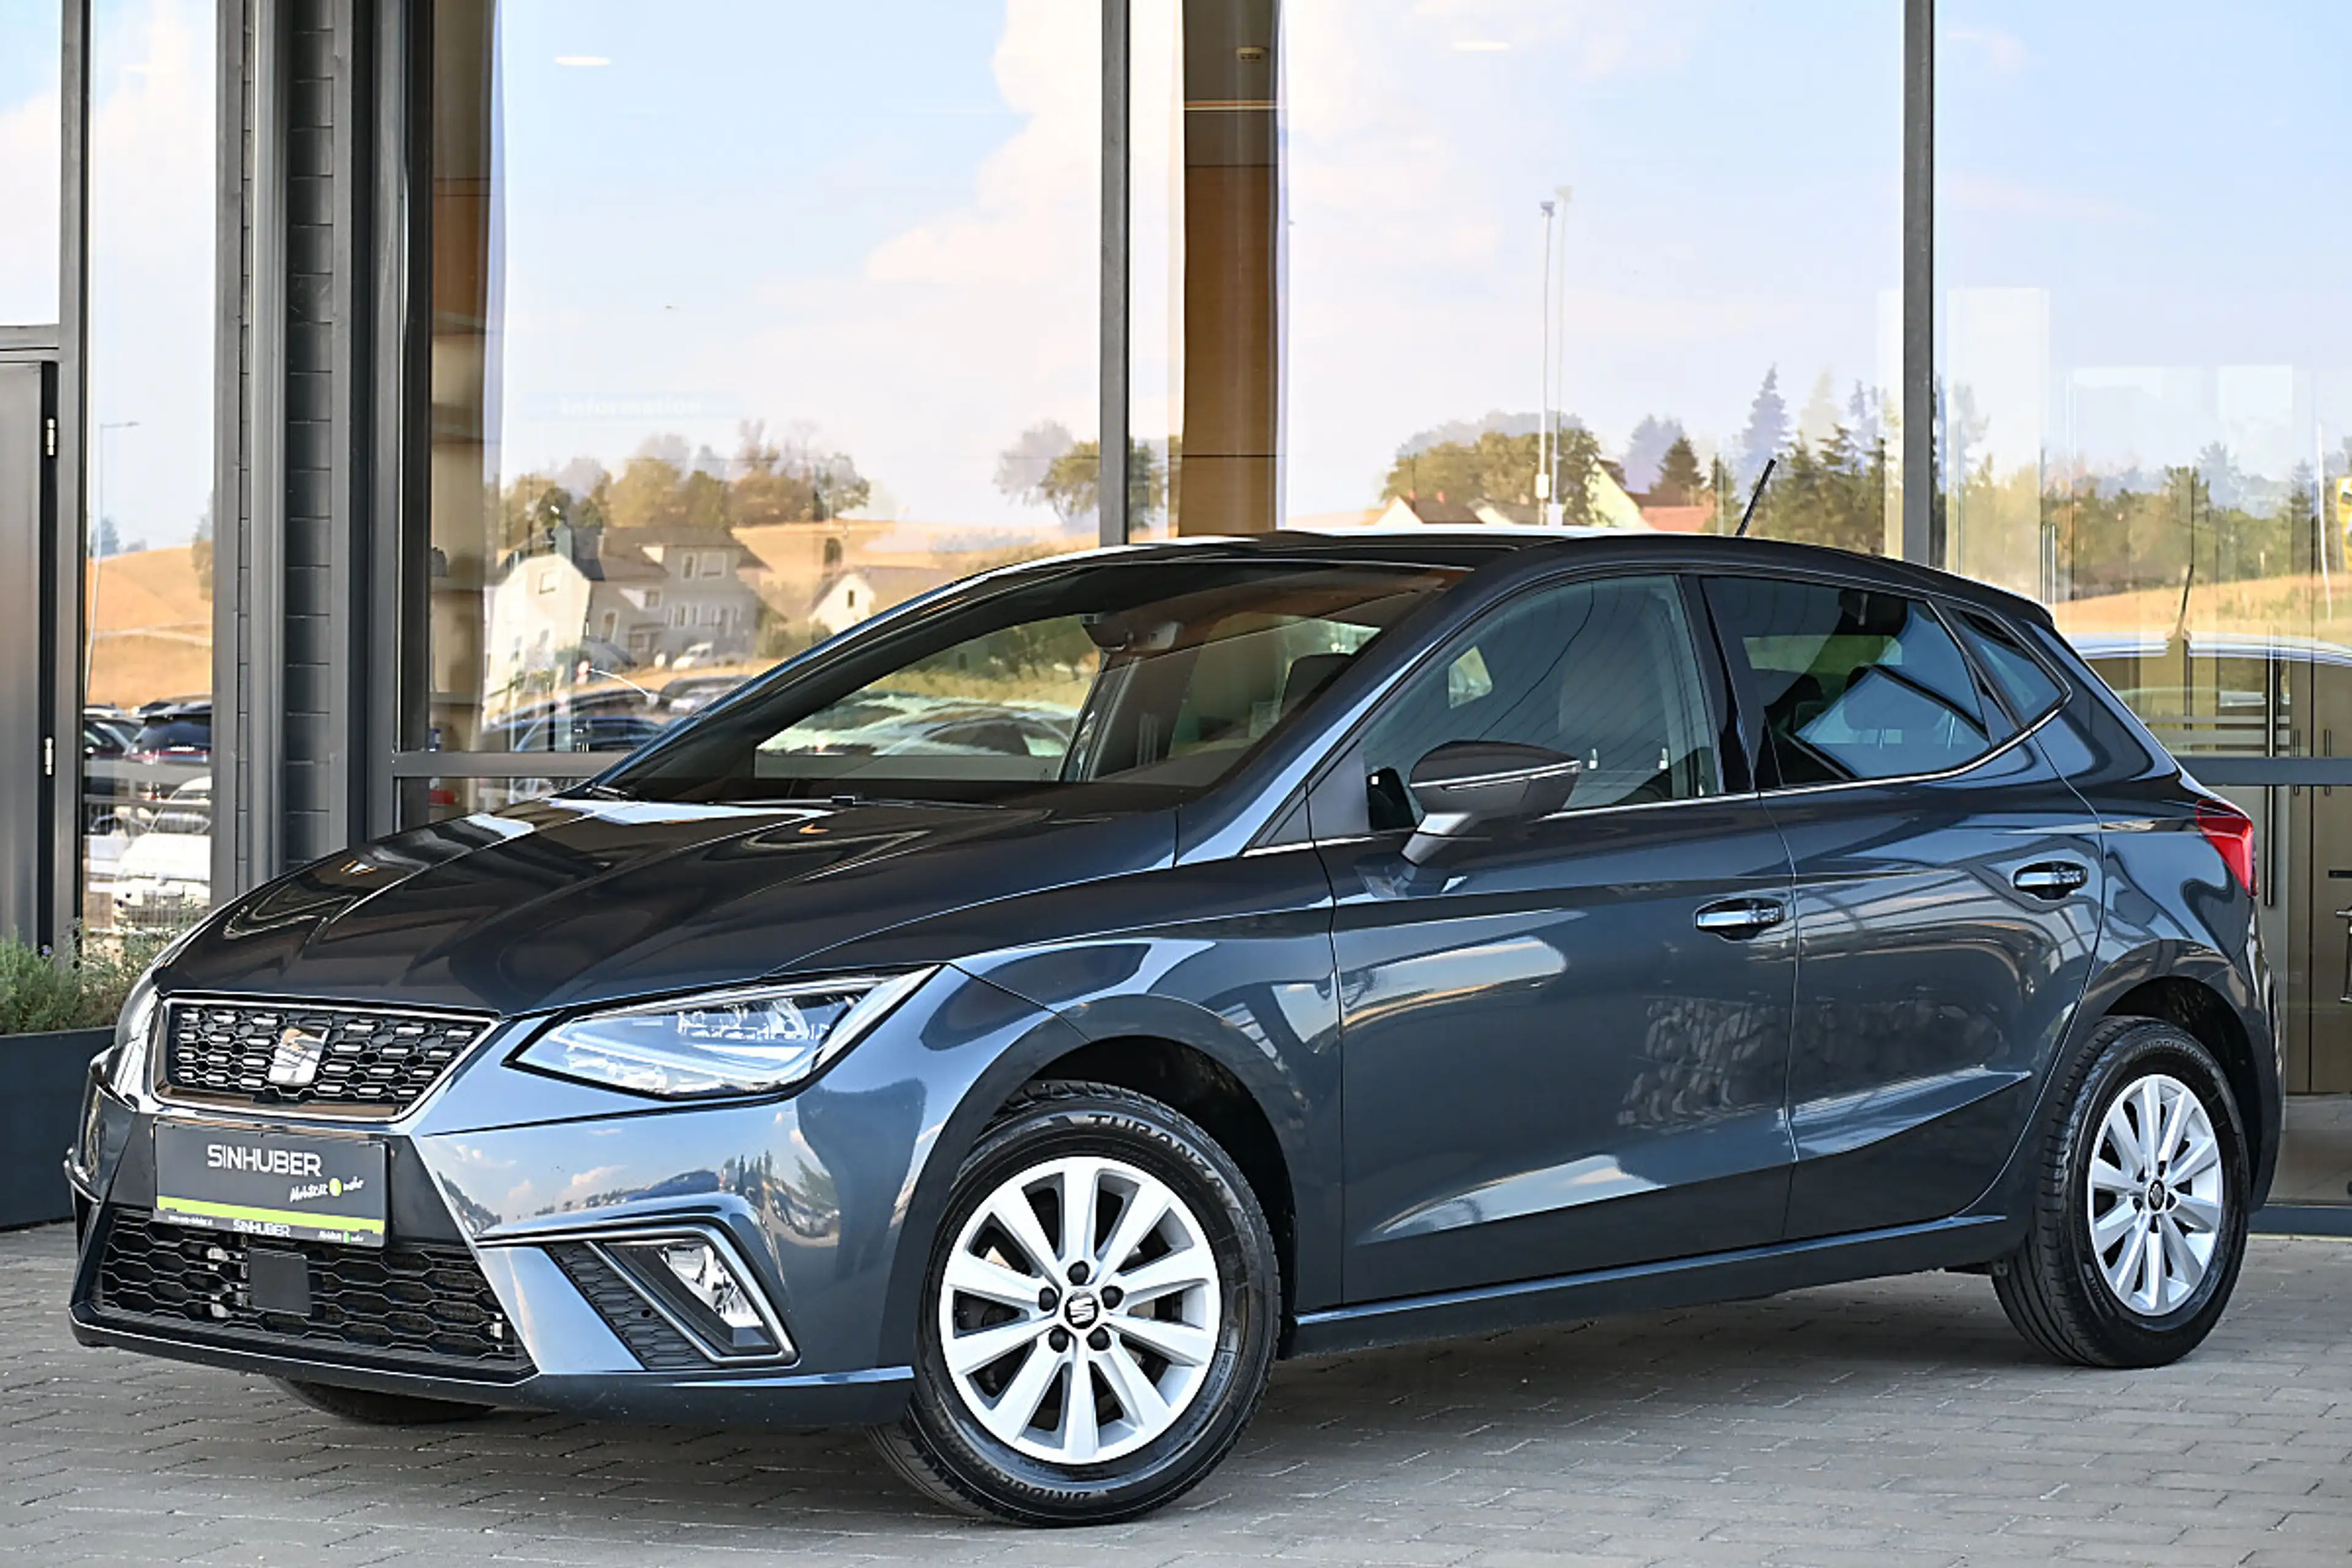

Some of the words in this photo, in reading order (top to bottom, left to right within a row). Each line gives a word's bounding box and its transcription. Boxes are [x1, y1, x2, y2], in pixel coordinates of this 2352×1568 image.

[560, 395, 701, 415] Information
[207, 1144, 323, 1177] SINHUBER
[1087, 1113, 1224, 1192] TURANZA
